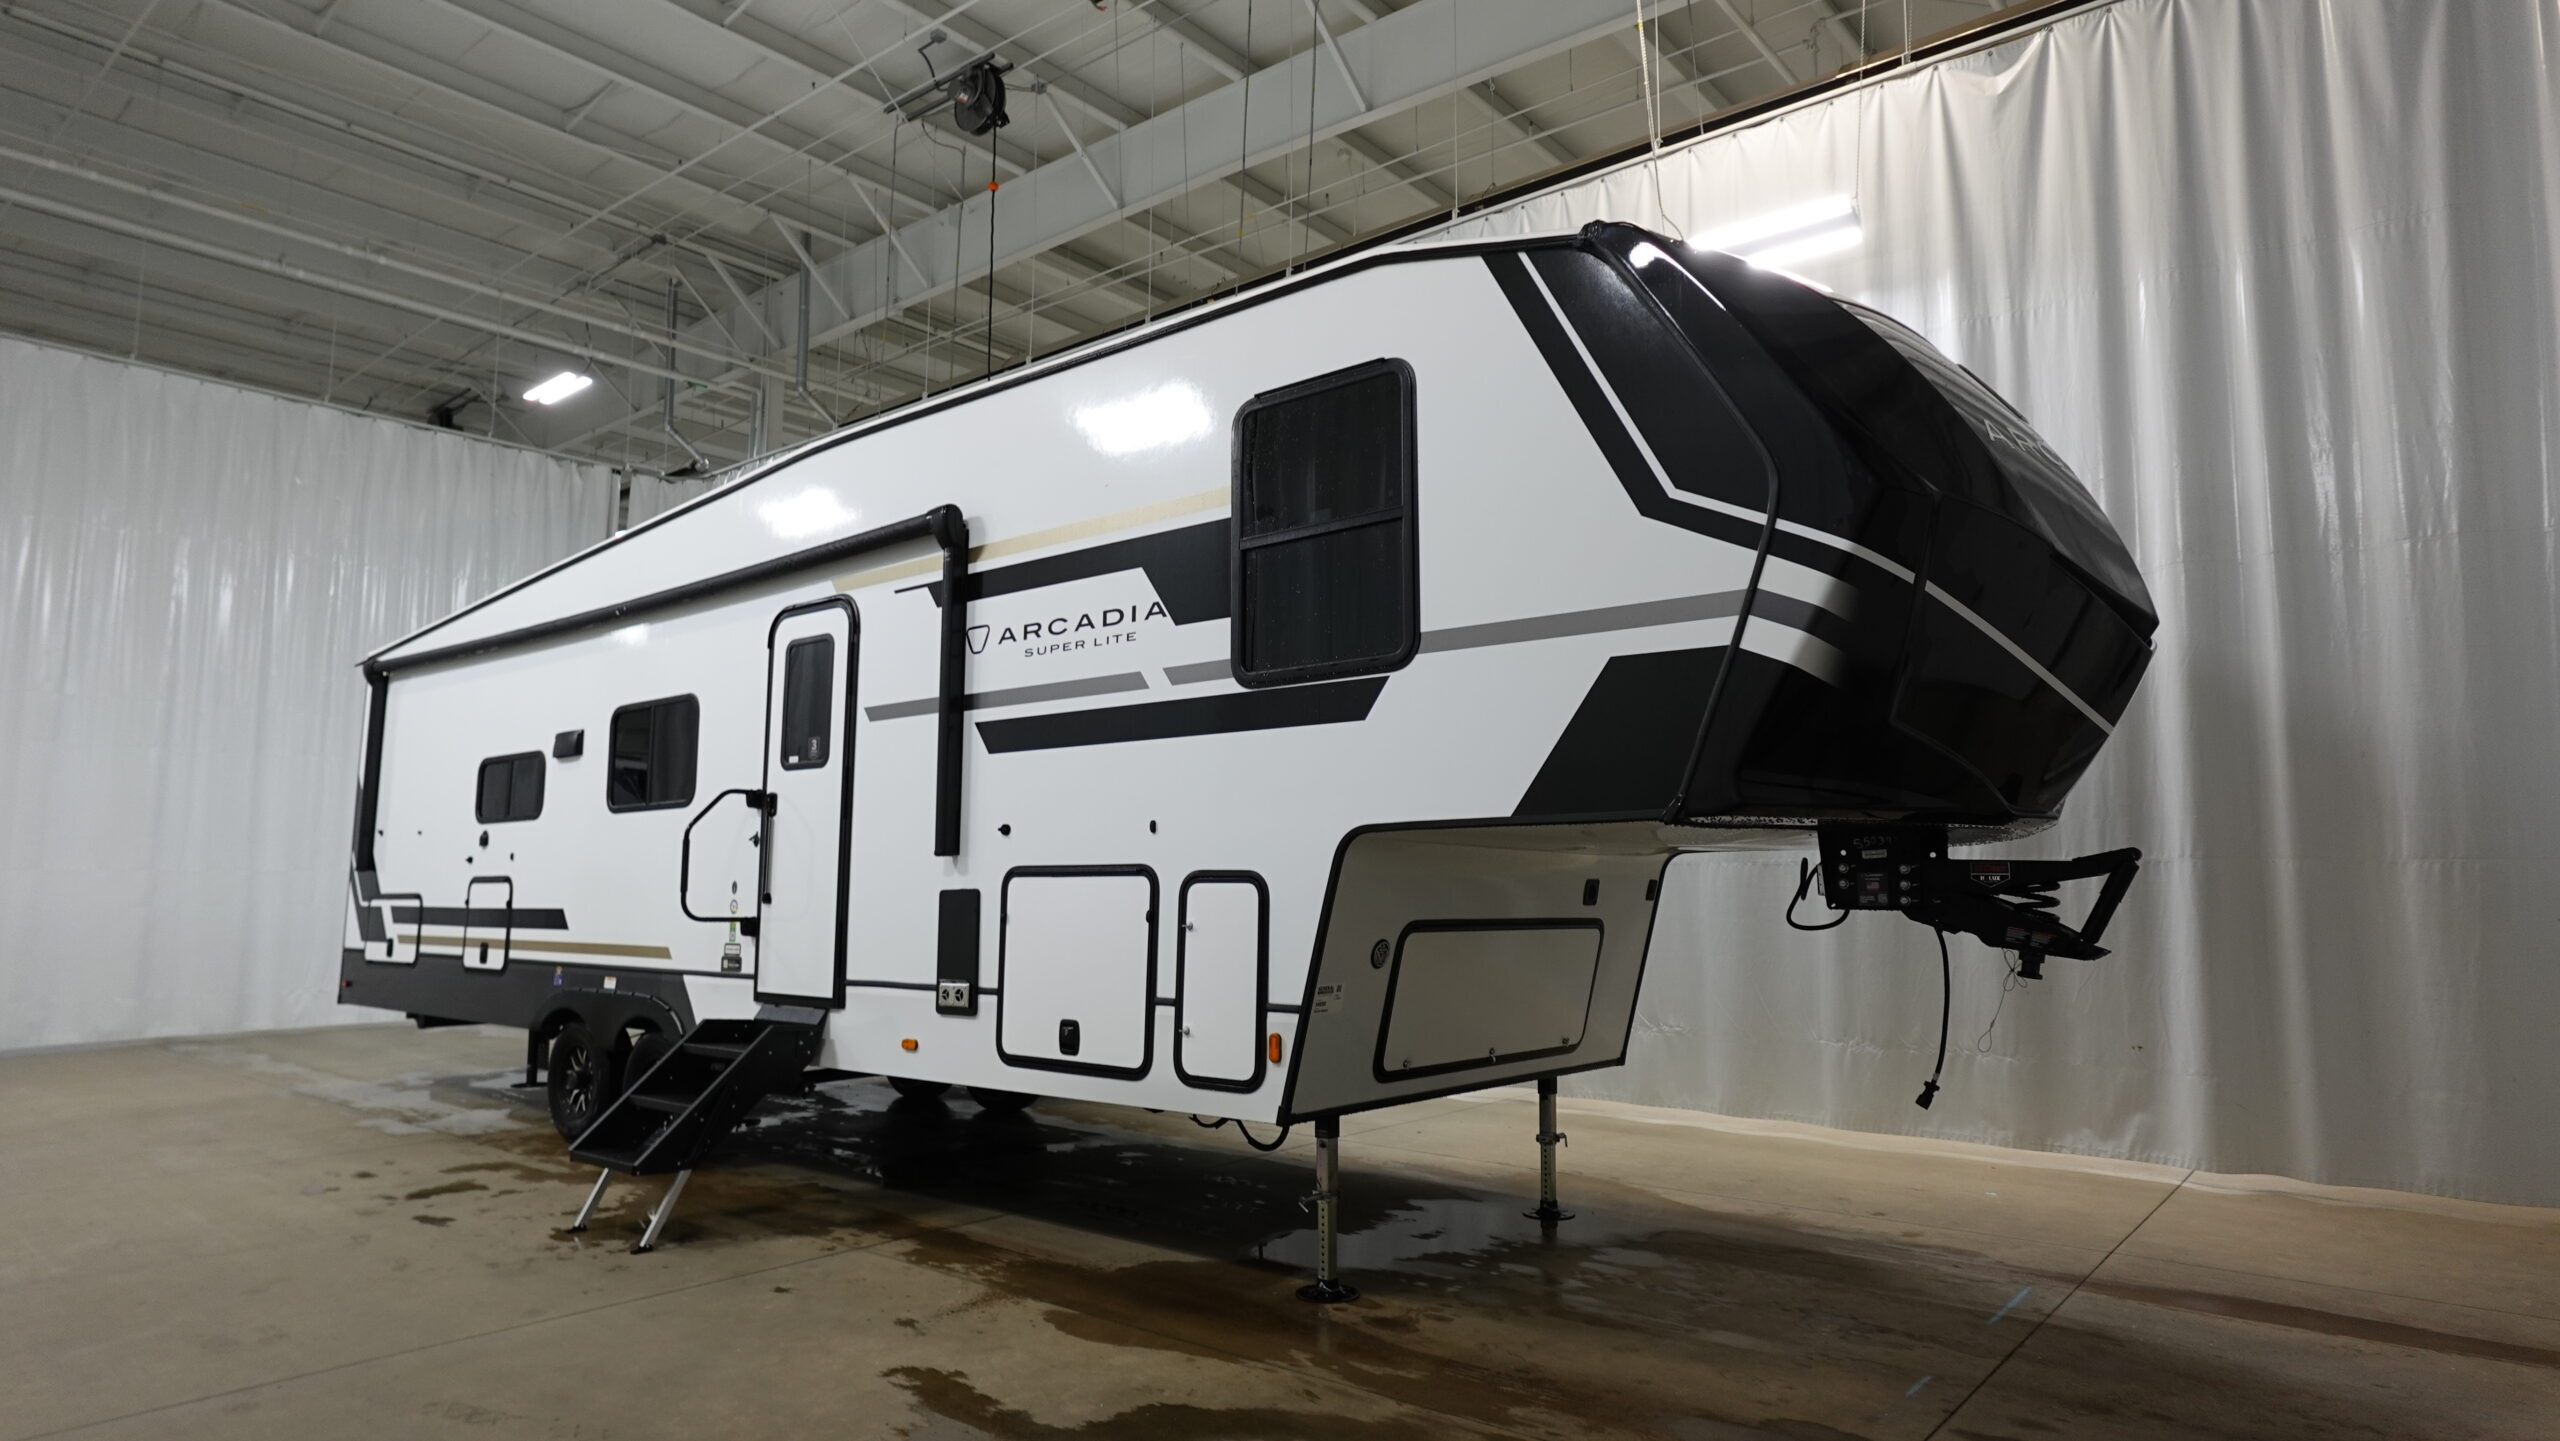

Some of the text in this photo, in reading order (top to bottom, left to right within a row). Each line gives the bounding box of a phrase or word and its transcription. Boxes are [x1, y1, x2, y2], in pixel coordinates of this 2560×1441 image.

[998, 601, 1167, 644] ARCADIA
[1024, 632, 1137, 657] SUPER LITE
